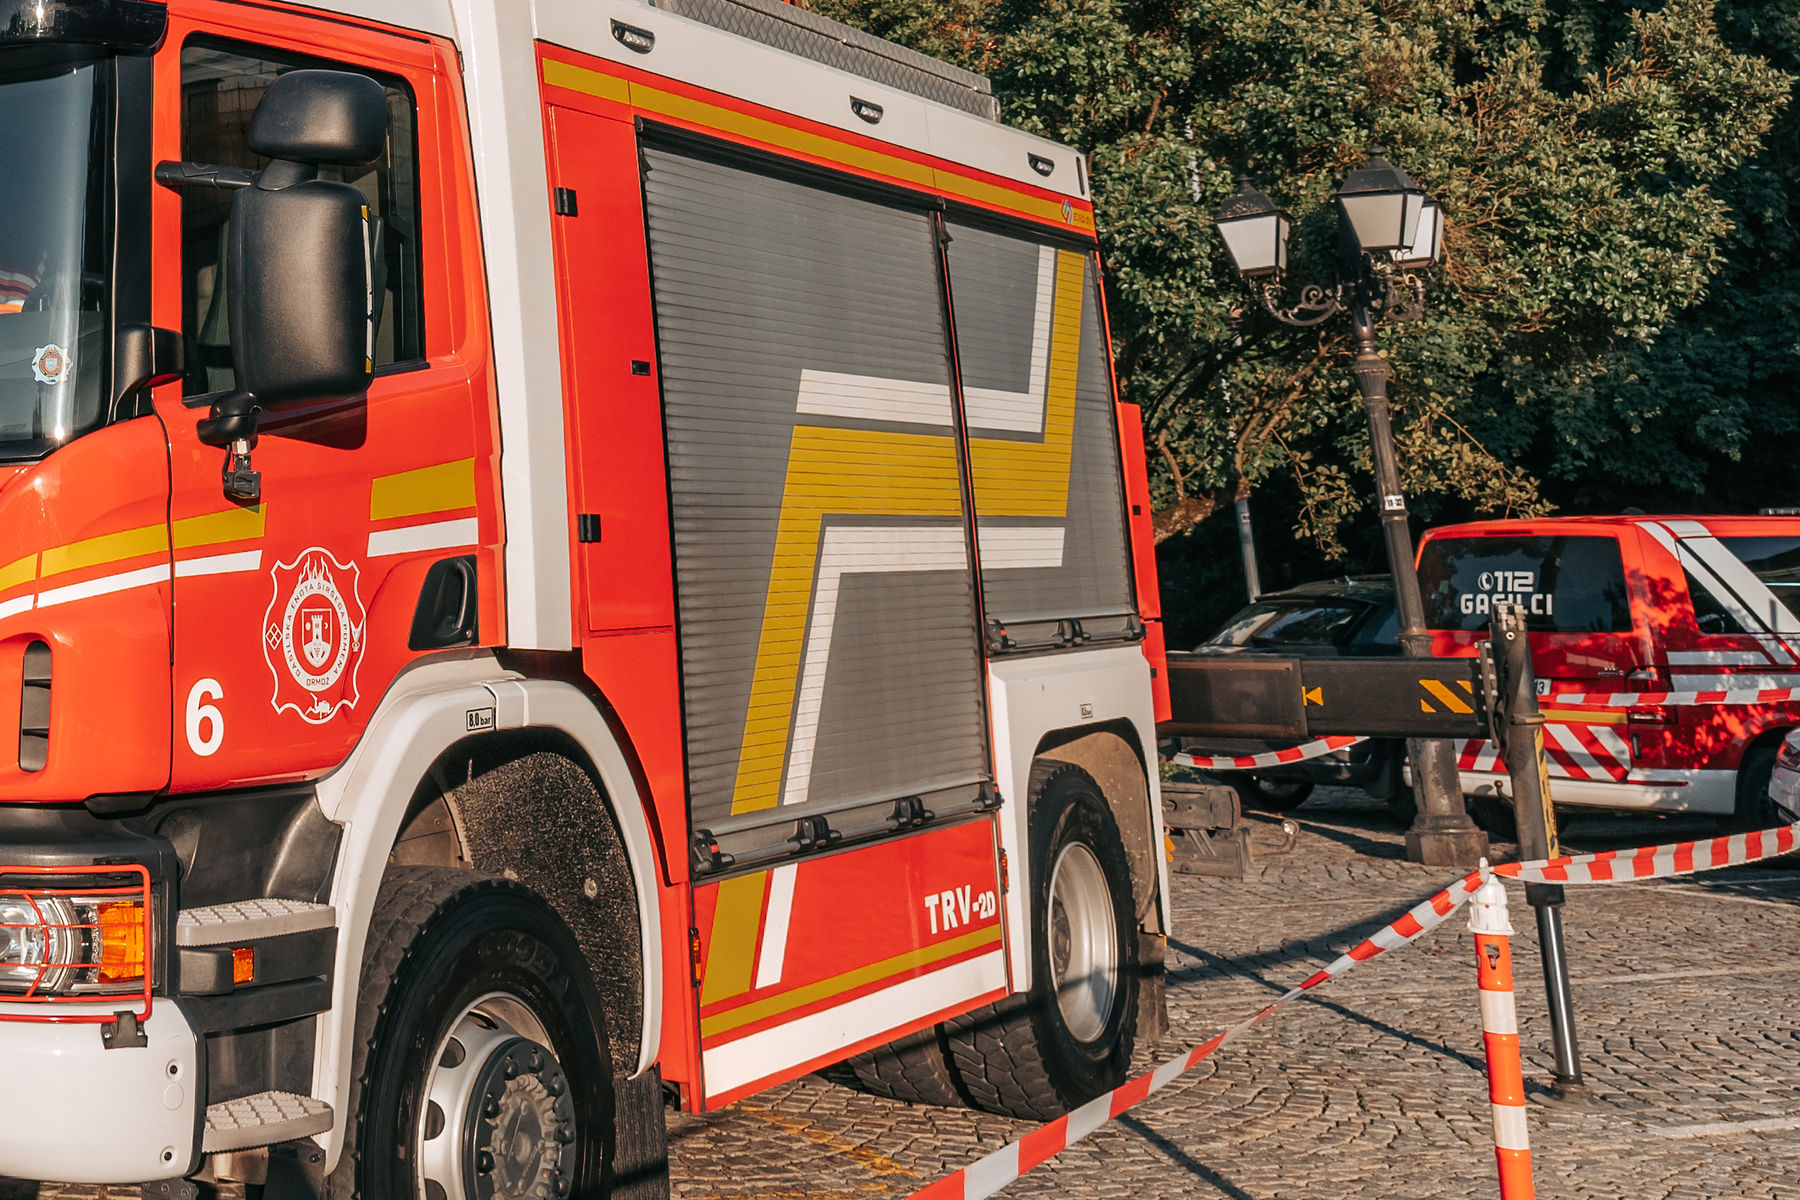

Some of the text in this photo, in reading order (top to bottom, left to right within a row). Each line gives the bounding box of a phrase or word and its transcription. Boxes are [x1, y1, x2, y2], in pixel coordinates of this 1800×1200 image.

[290, 583, 314, 610] ENOTA
[1494, 571, 1534, 592] 112
[285, 614, 301, 677] GASILSKA
[333, 624, 347, 674] POMENA
[306, 677, 330, 686] ORMOŽ
[185, 678, 224, 757] 6
[480, 716, 491, 725] bar
[924, 884, 996, 935] TRV-2D
